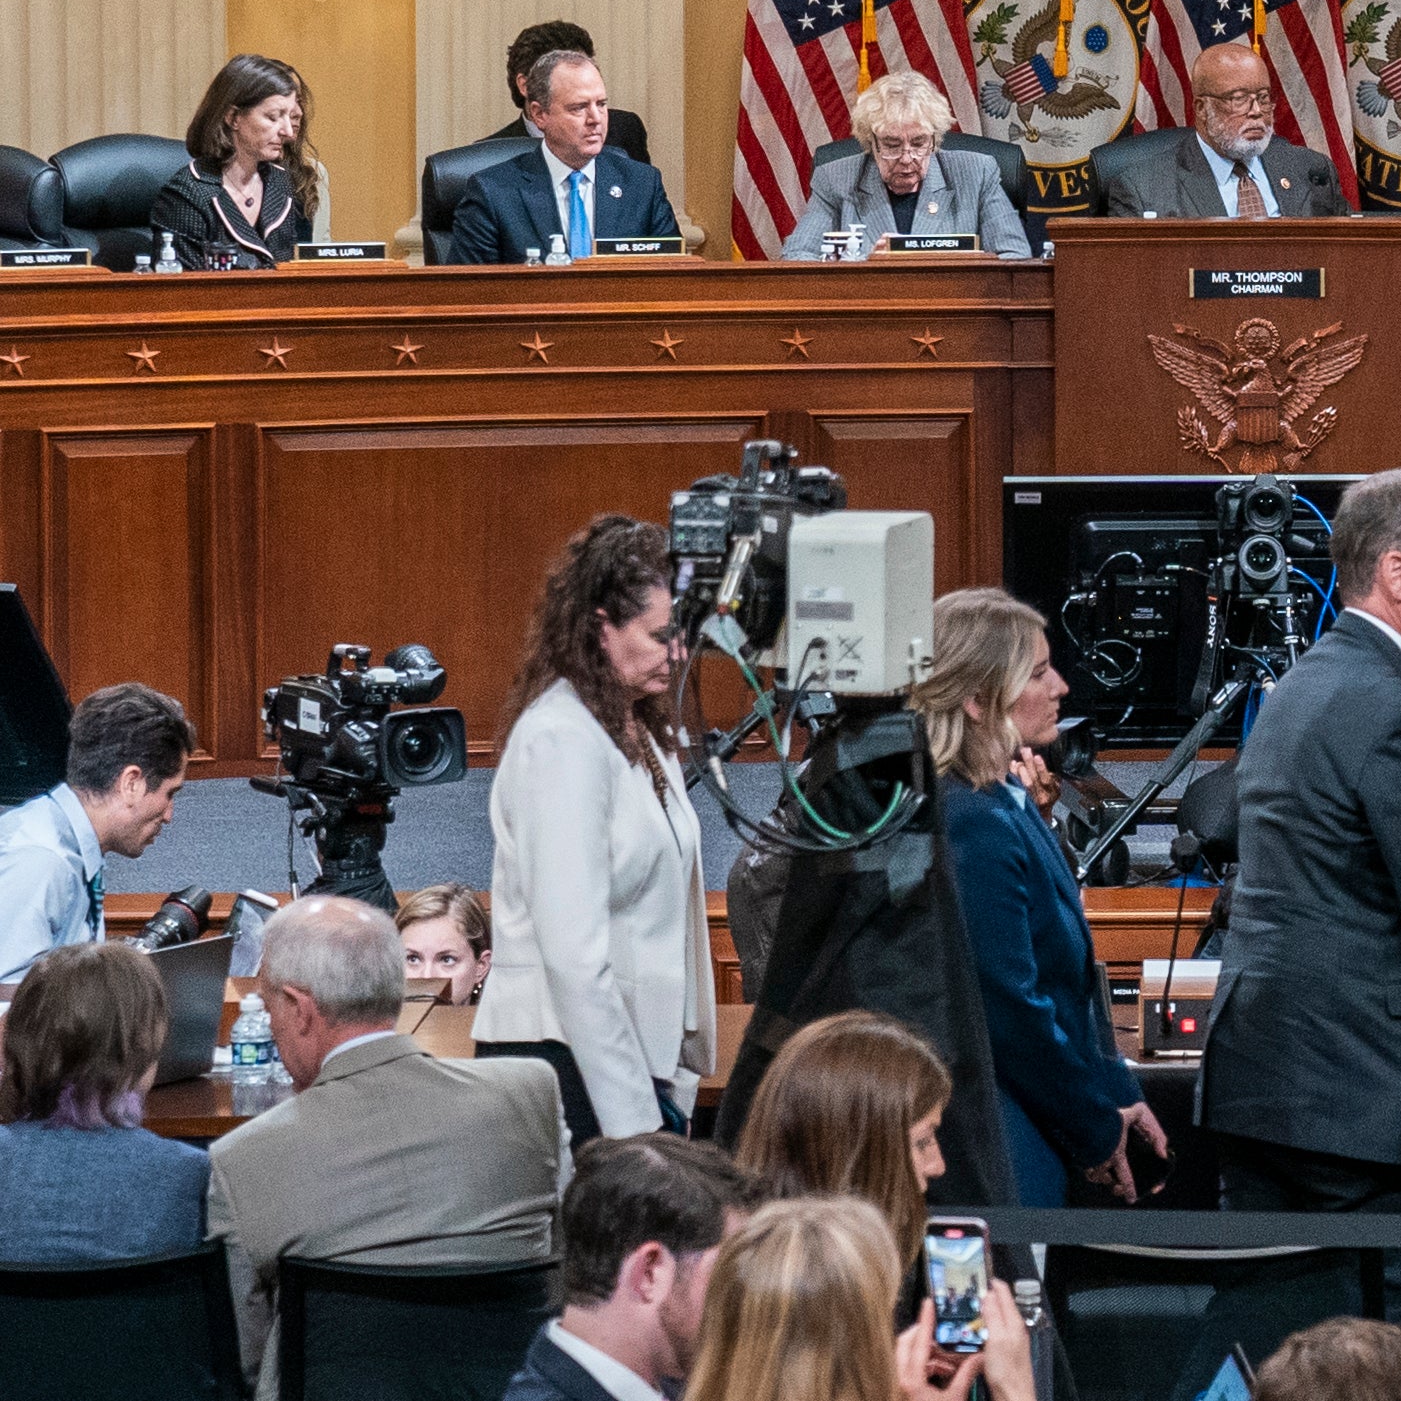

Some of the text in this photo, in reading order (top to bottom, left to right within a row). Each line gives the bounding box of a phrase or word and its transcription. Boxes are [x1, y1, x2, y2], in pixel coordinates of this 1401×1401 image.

[615, 242, 662, 252] MR. SCHIFF
[904, 240, 960, 249] MS. LOFGREN
[318, 247, 364, 257] MRS. LURIA
[14, 253, 73, 264] MRS. MURPHY
[1211, 271, 1303, 284] MR. THOMPSON
[1231, 284, 1283, 295] CHAIRMAN
[1207, 604, 1217, 649] SONY
